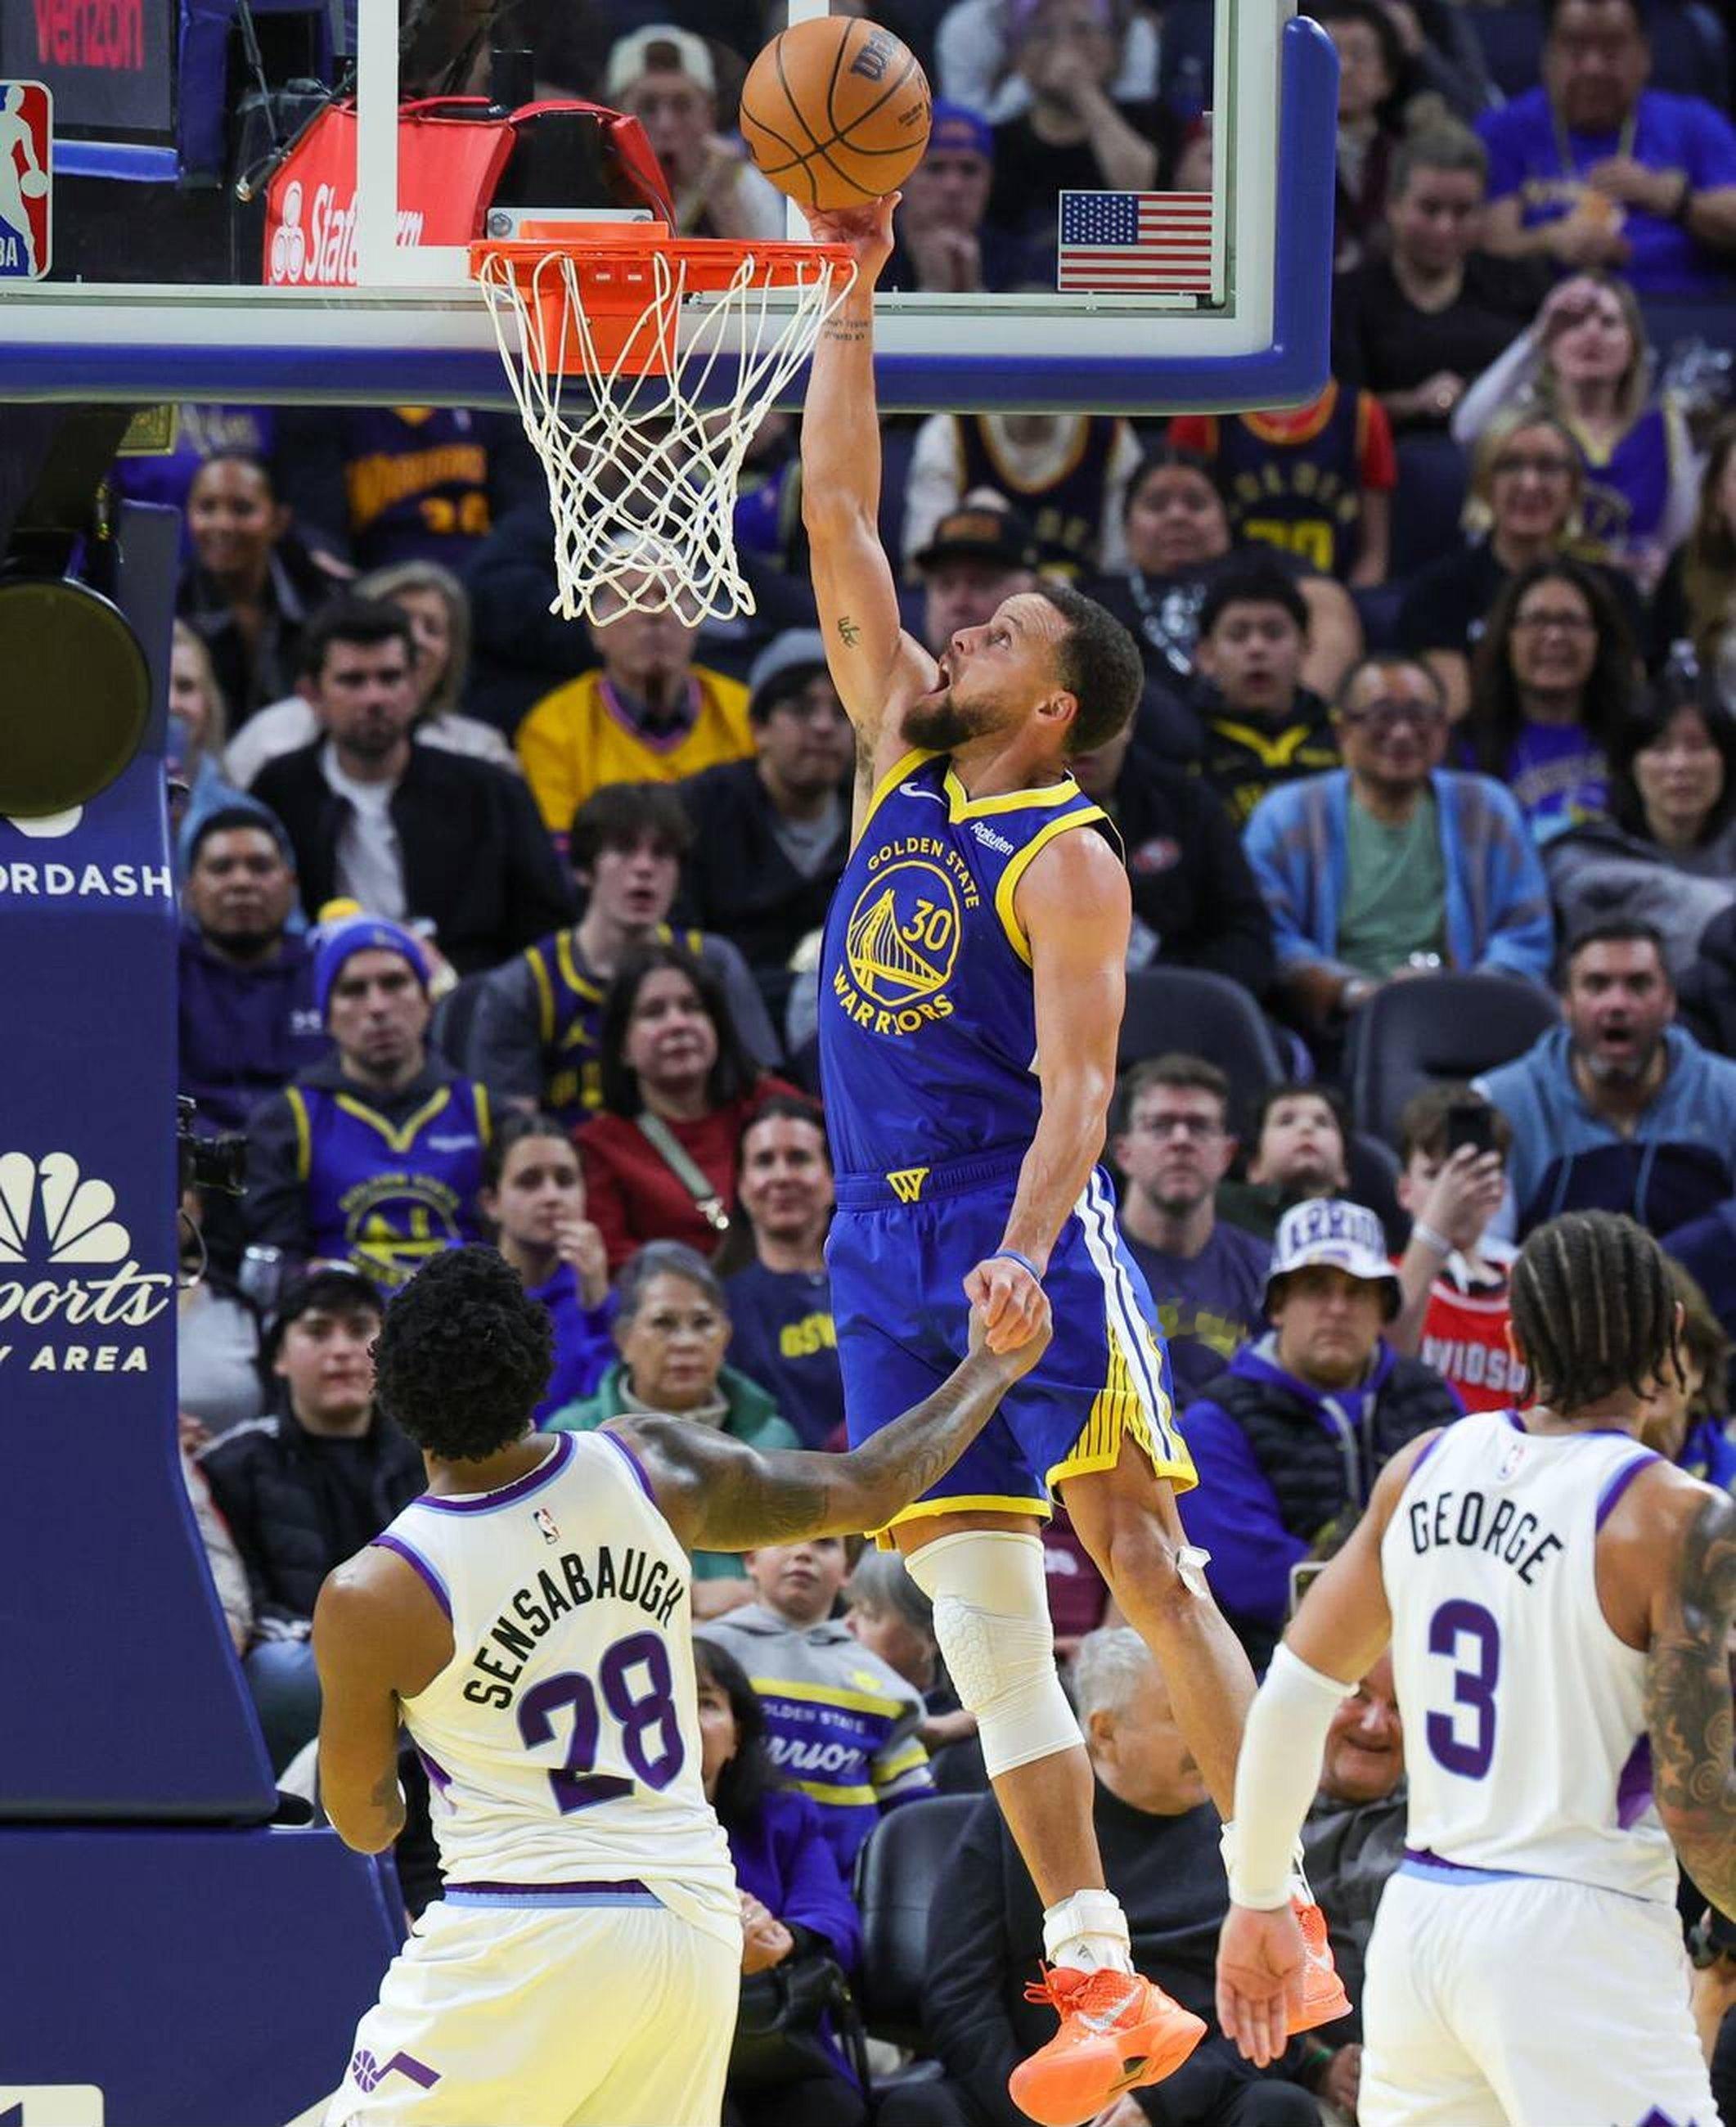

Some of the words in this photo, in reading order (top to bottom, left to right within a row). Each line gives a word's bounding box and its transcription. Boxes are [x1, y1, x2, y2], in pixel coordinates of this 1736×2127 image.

[867, 837, 943, 870] GOLDEN
[946, 851, 979, 909] STATE
[970, 821, 1014, 856] Rakuten
[0, 862, 173, 898] RDASH
[902, 899, 952, 951] 30
[834, 965, 954, 1035] WARRIORS
[29, 1346, 148, 1372] AREA
[1410, 1491, 1563, 1586] GEORGE
[463, 1546, 684, 1710] SENSABAUGH
[516, 1630, 685, 1817] 28
[1426, 1598, 1500, 1782] 3
